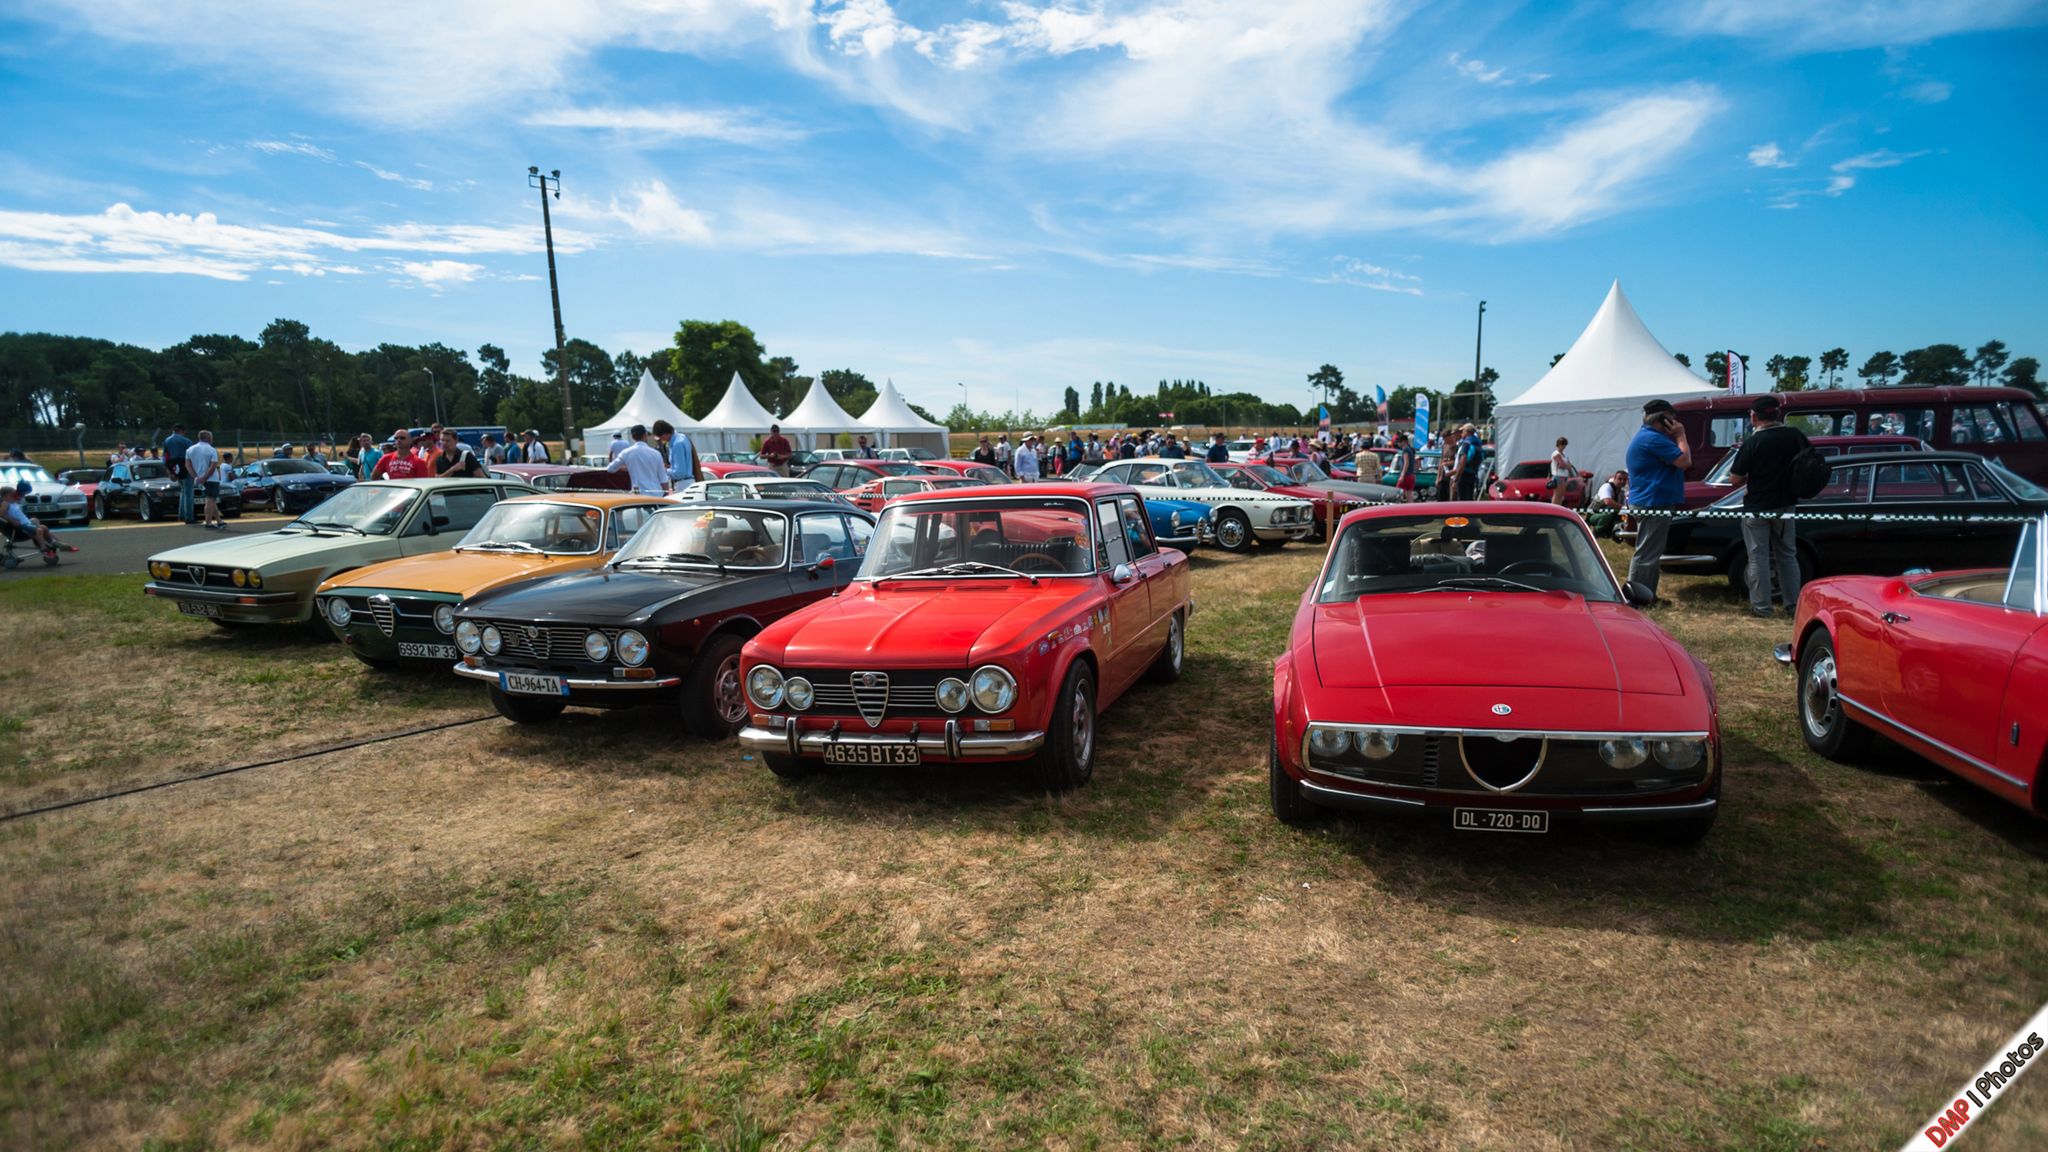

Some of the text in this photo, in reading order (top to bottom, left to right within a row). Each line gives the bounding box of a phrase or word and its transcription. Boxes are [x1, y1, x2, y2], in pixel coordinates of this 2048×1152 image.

[399, 643, 457, 658] 6992 NP 33
